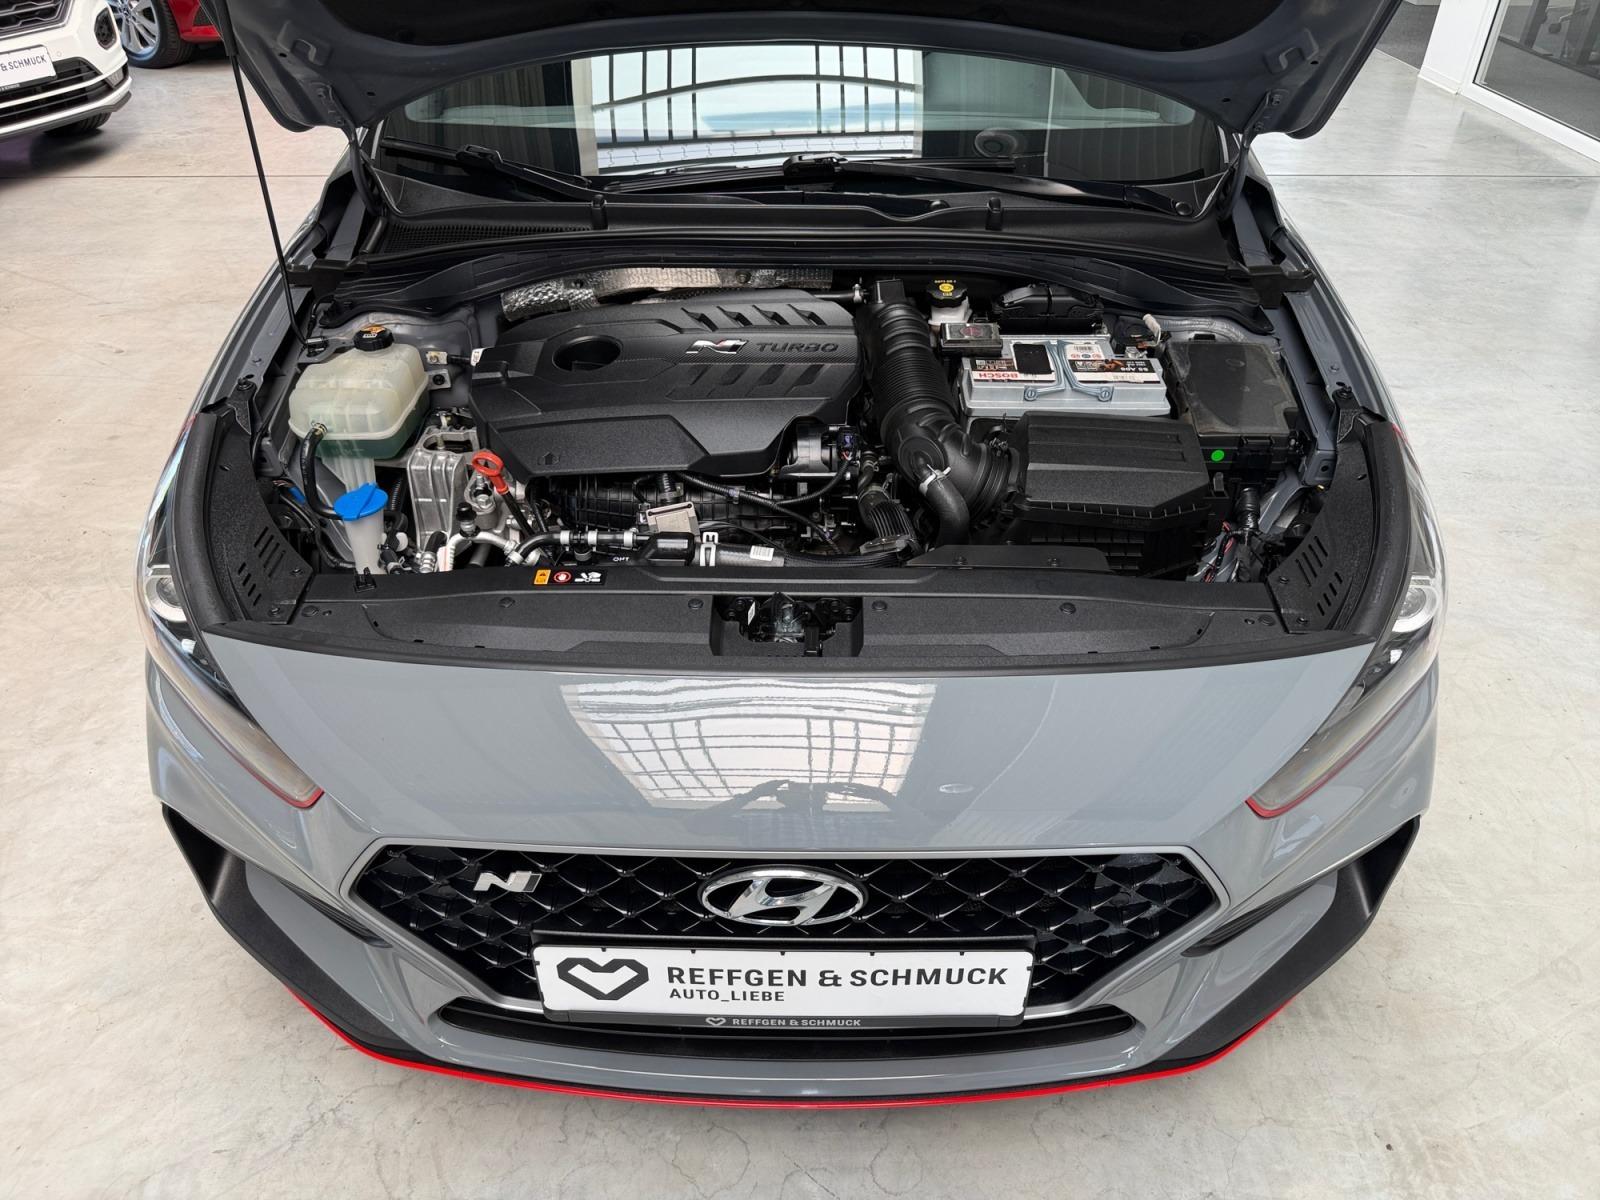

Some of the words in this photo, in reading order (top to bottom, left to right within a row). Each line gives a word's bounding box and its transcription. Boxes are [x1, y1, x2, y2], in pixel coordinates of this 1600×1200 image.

[8, 55, 47, 69] SCHMUCK
[756, 342, 839, 353] TURBO
[978, 372, 1019, 380] BOSCH
[667, 966, 807, 987] REFFGEN
[818, 969, 843, 987] &
[849, 968, 1008, 987] SCHMUCK
[669, 988, 785, 1002] AUTO_LIEBE
[732, 1018, 786, 1026] REFFGEN
